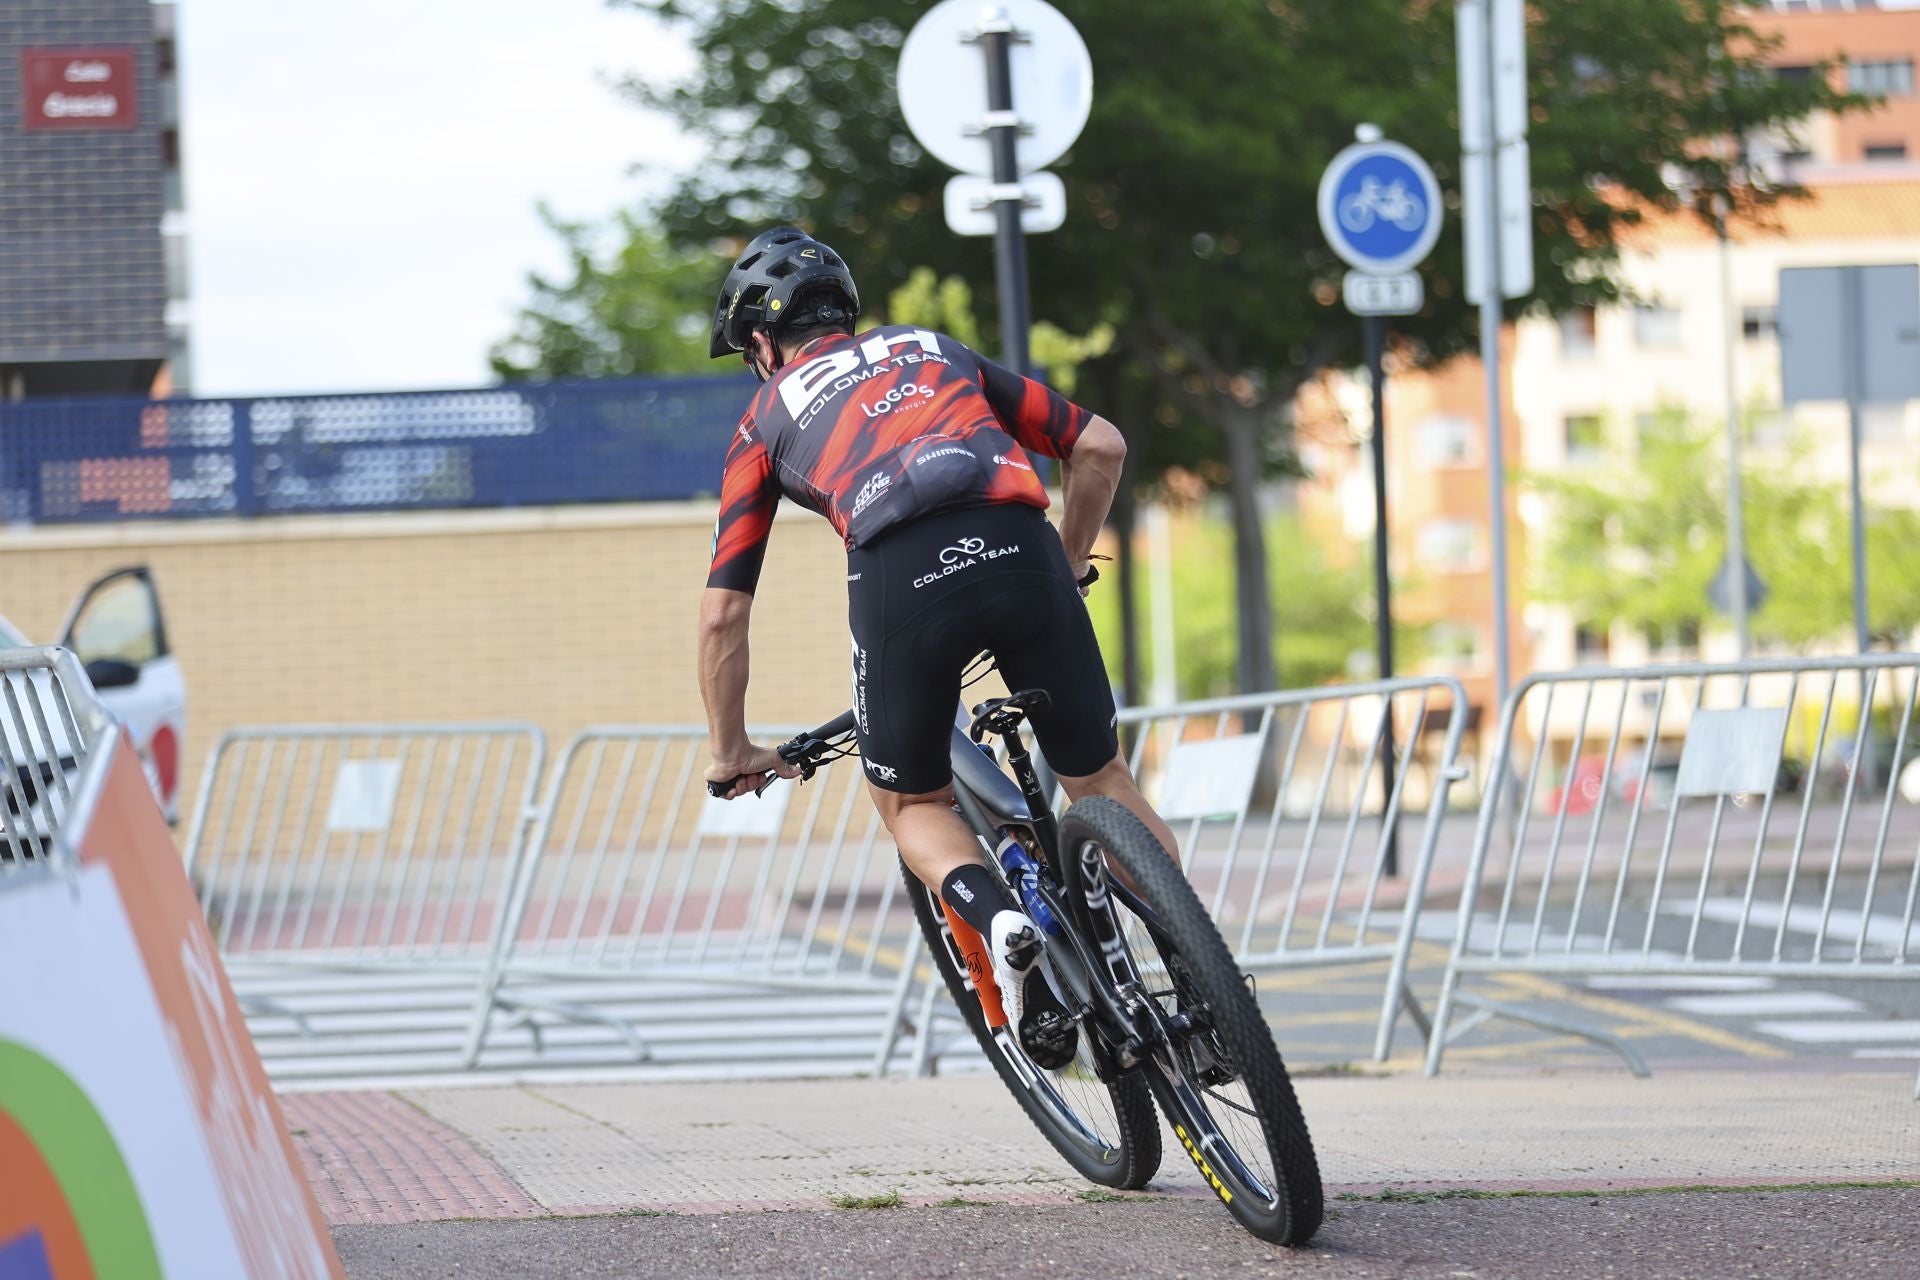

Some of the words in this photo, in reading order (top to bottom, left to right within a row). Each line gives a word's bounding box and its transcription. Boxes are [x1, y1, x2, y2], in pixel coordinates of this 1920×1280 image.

[778, 330, 941, 421] BH
[799, 365, 890, 430] COLOMA
[891, 353, 952, 367] TEAM
[913, 558, 976, 589] COLOMA
[980, 545, 1020, 561] TEAM
[859, 648, 867, 682] TEAM
[859, 686, 869, 736] COLOMA
[865, 757, 898, 783] FOX
[1175, 1124, 1233, 1204] MAXXIS
